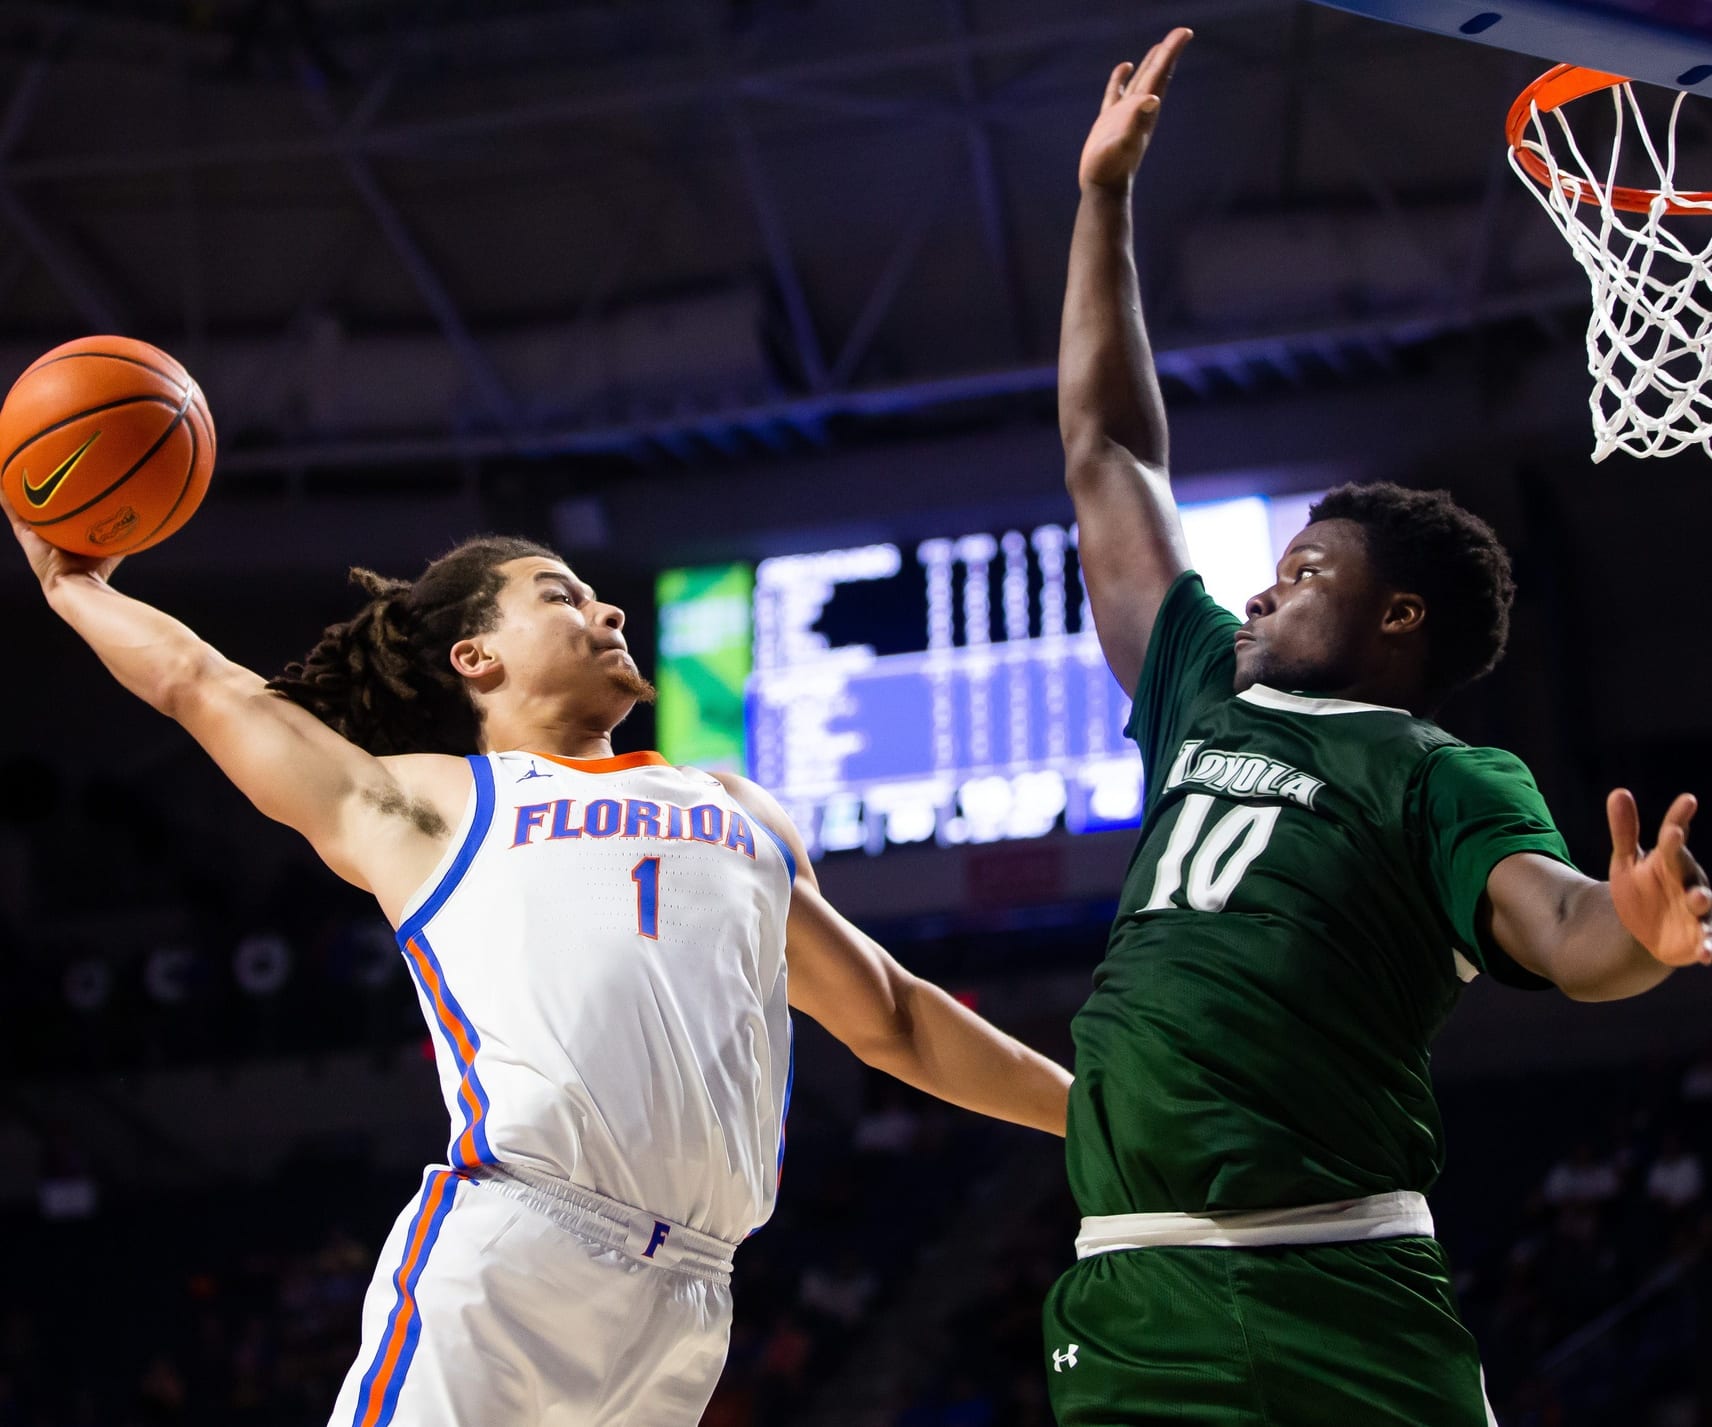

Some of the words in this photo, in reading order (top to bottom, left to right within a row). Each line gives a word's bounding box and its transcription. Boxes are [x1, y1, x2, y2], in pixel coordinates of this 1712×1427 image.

[1162, 739, 1327, 811] LOYOLA
[508, 798, 756, 860] FLORIDA
[1135, 793, 1282, 913] 10
[631, 855, 661, 940] 1
[640, 1219, 672, 1259] F
